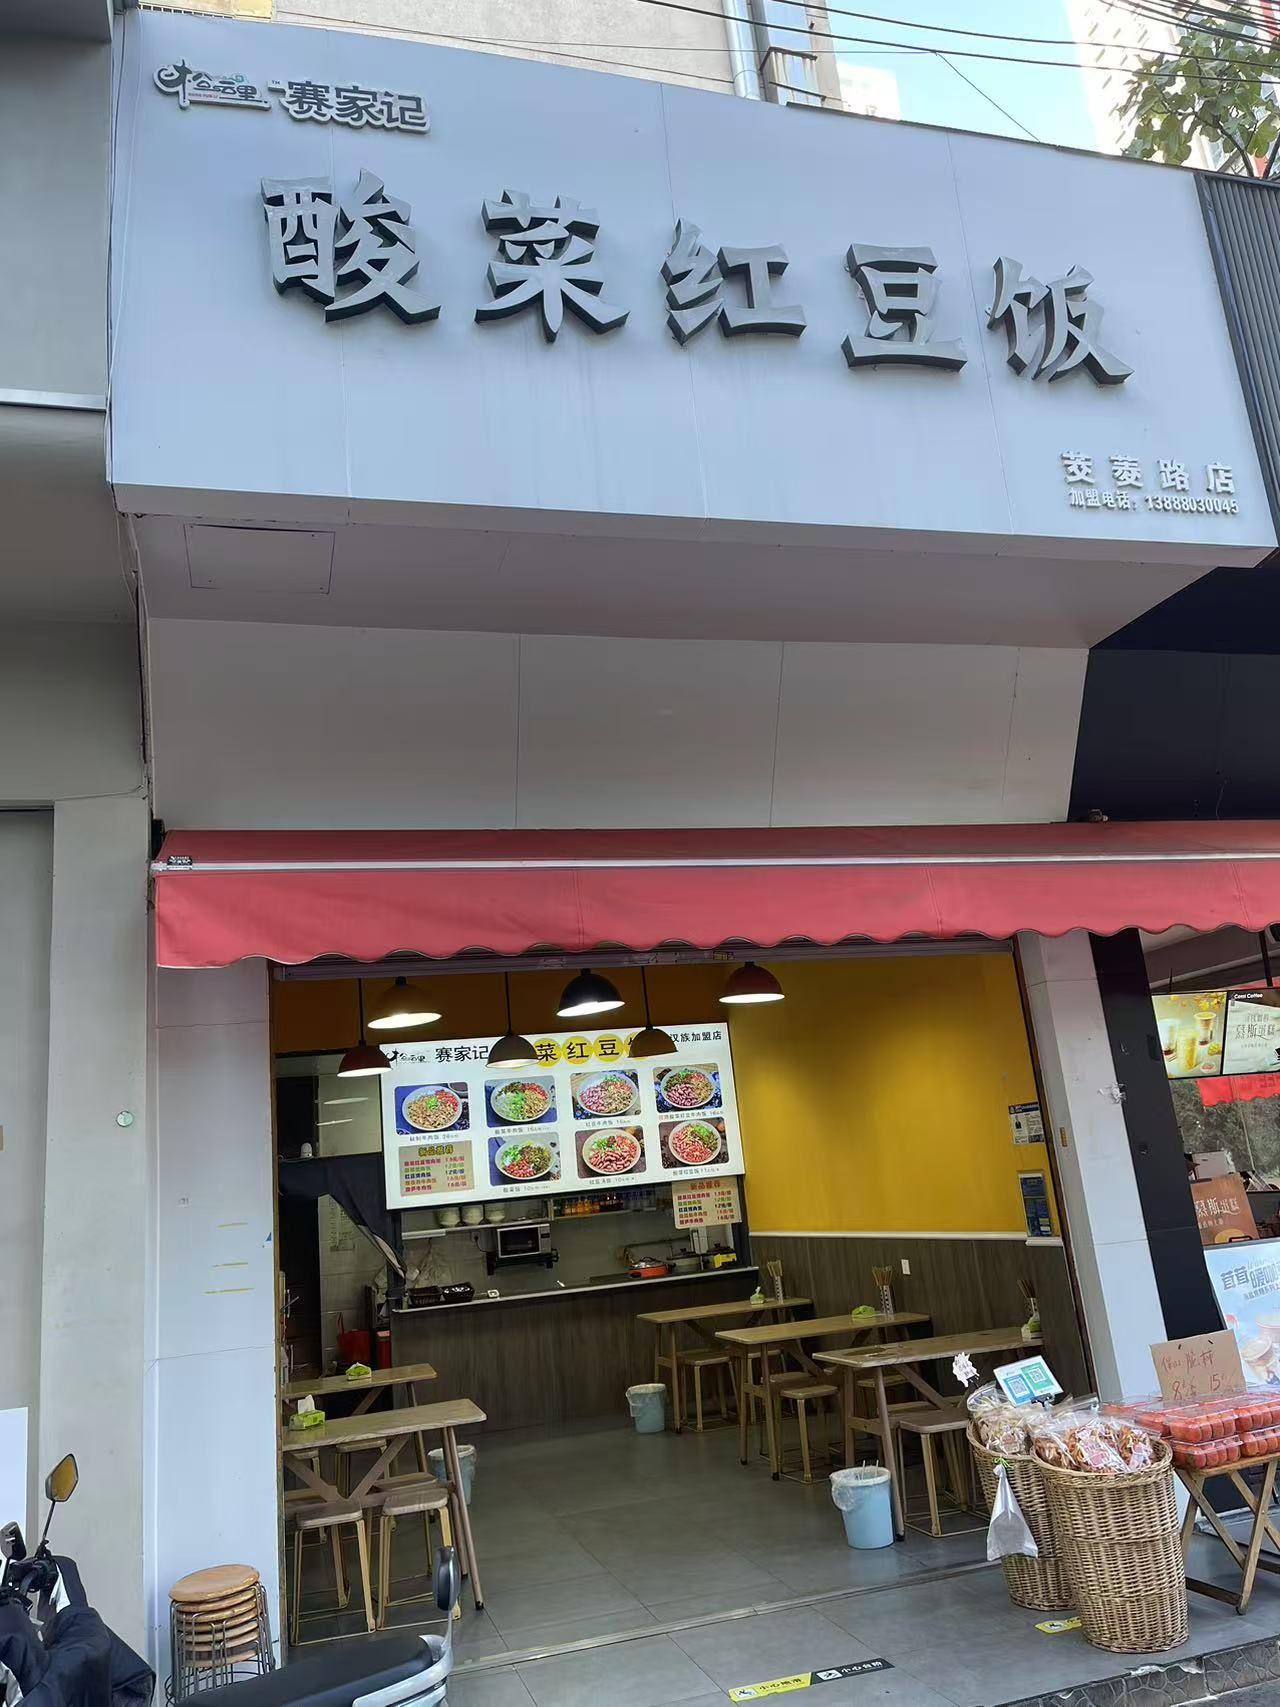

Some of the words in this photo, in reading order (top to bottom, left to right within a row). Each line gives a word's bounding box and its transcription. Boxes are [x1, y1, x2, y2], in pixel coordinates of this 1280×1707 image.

[287, 79, 427, 129] 赛家记
[260, 168, 1135, 387] 酸菜红豆饭
[435, 1045, 489, 1063] 赛家记
